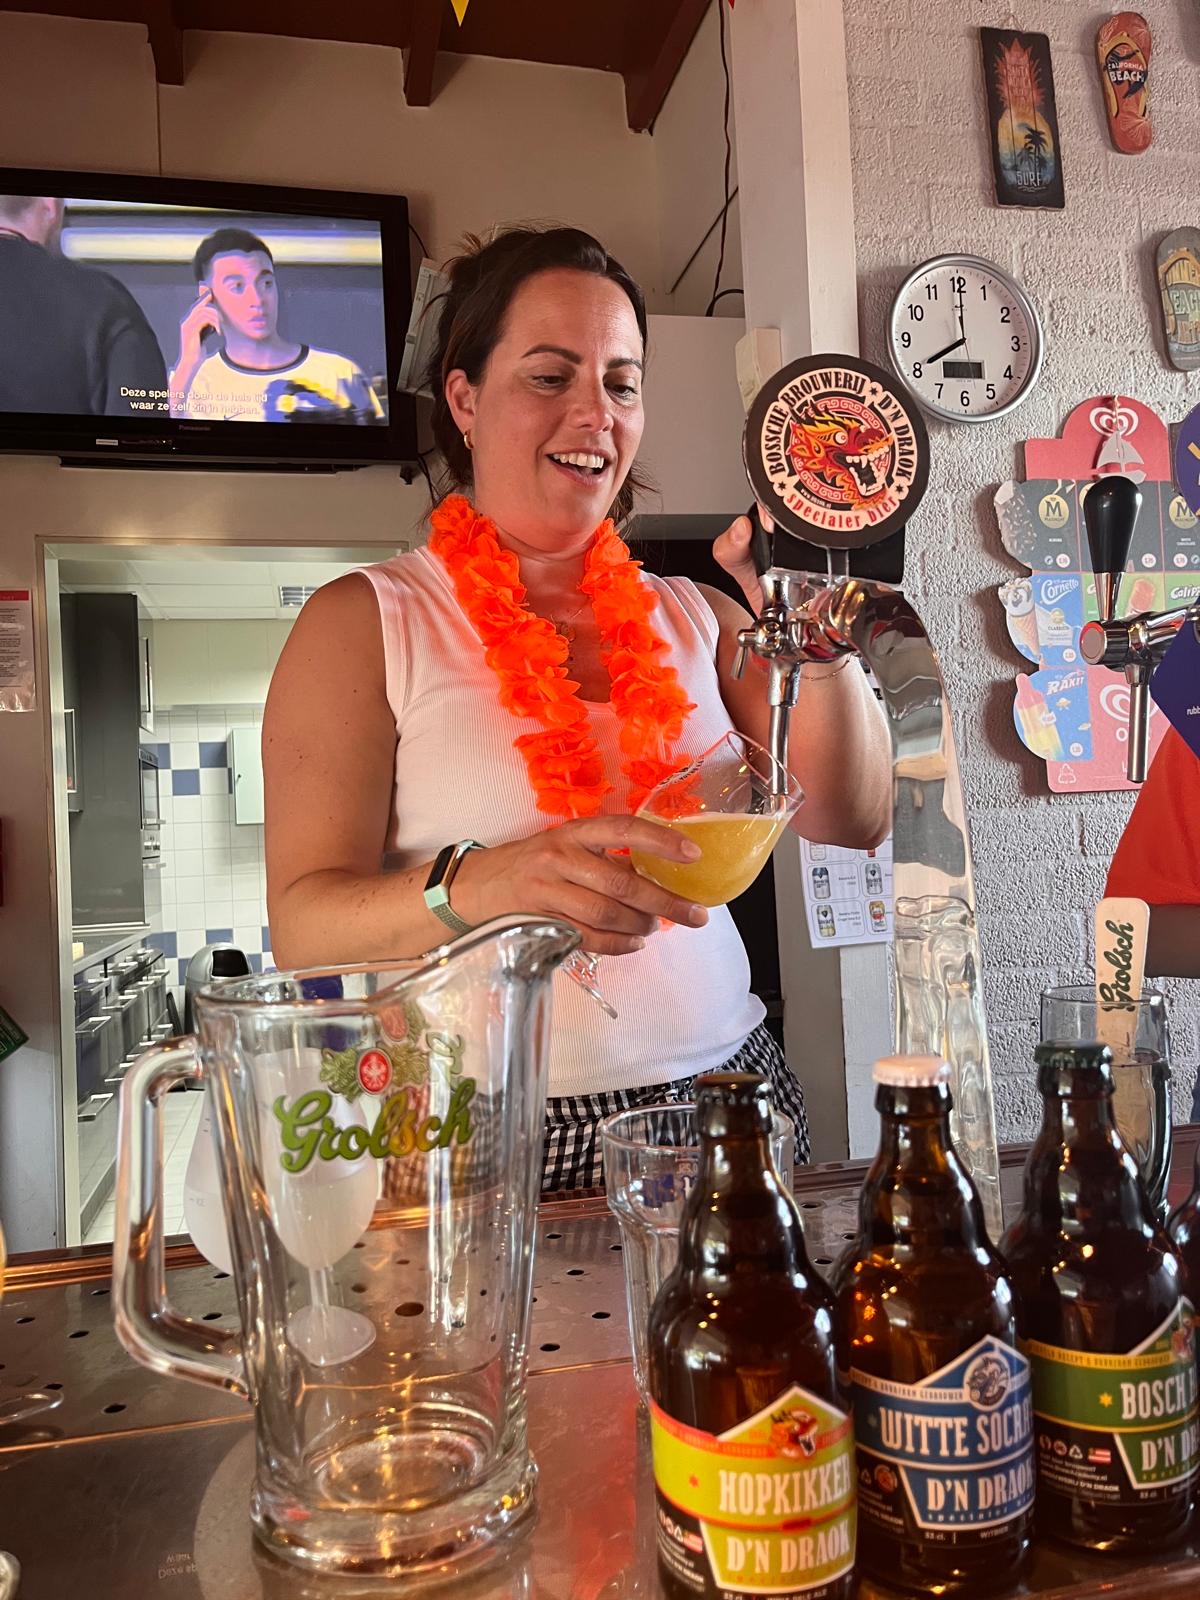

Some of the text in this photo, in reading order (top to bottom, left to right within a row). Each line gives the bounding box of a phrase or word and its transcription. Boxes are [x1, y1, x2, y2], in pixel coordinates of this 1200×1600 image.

[1107, 62, 1144, 71] CALIFORNIA
[1109, 71, 1145, 82] BEACH
[1016, 170, 1041, 187] SURF
[925, 284, 938, 300] 11
[949, 276, 966, 293] 12
[980, 285, 987, 301] 1
[907, 304, 924, 321] 10
[1000, 306, 1011, 323] 2
[901, 331, 911, 348] 9
[1011, 335, 1020, 352] 3
[912, 362, 923, 378] 8
[1003, 365, 1013, 380] 4
[120, 387, 146, 397] Deze
[148, 389, 185, 400] spelers
[934, 383, 944, 399] 7
[960, 390, 970, 406] 6
[986, 383, 996, 400] 5
[130, 401, 155, 411] waar
[157, 402, 169, 411] ze
[172, 402, 190, 412] zelf
[766, 371, 866, 476] BOSSCHE BROUWERIJ
[894, 423, 915, 483] DRAOK
[786, 493, 861, 529] specialer
[867, 495, 899, 523] bier
[1045, 501, 1063, 517] M
[1041, 578, 1079, 605] Cornetto
[1099, 919, 1135, 1012] Grolsch
[273, 1078, 477, 1173] Grolsch
[1120, 1372, 1186, 1420] BOSCH
[880, 1406, 970, 1457] WITTE
[718, 1452, 851, 1516] HOPKIKKER
[978, 1457, 1033, 1511] DRAOK
[780, 1519, 850, 1574] DRAOK
